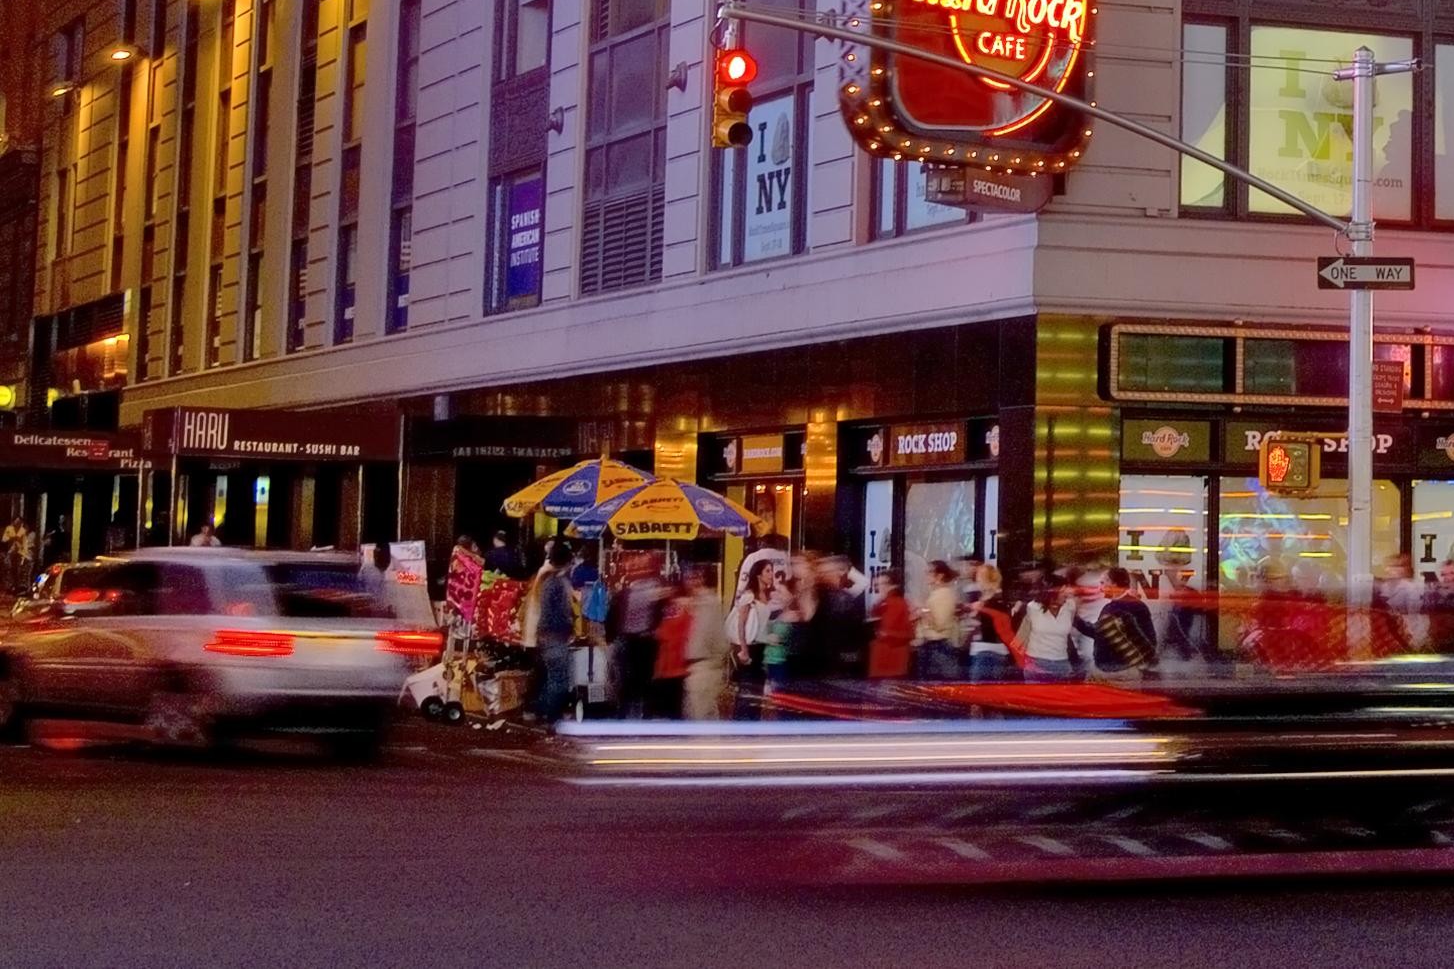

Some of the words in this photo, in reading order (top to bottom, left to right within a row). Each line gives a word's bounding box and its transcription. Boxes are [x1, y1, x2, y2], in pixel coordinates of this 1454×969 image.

[977, 31, 1025, 60] CAFE
[1278, 49, 1306, 98] I
[757, 121, 767, 164] I
[755, 167, 791, 215] NY
[973, 179, 1021, 202] SPECTACOLOR
[511, 208, 540, 230] SPANISH
[511, 228, 540, 250] AMERICAN
[1330, 266, 1357, 280] ONE
[1375, 267, 1403, 280] WAY
[14, 434, 92, 446] Delicatessen
[183, 411, 230, 450] HARU
[1143, 431, 1165, 444] Hard
[1167, 432, 1189, 447] Rock
[66, 447, 134, 458] Resrant
[233, 440, 299, 454] RESTAURANT
[305, 443, 337, 455] SUSHI
[340, 445, 360, 456] BAR
[897, 434, 927, 455] ROCK
[927, 431, 957, 452] SHOP
[119, 458, 152, 469] Pizza
[616, 522, 693, 535] SABRETT
[1420, 533, 1437, 563] I
